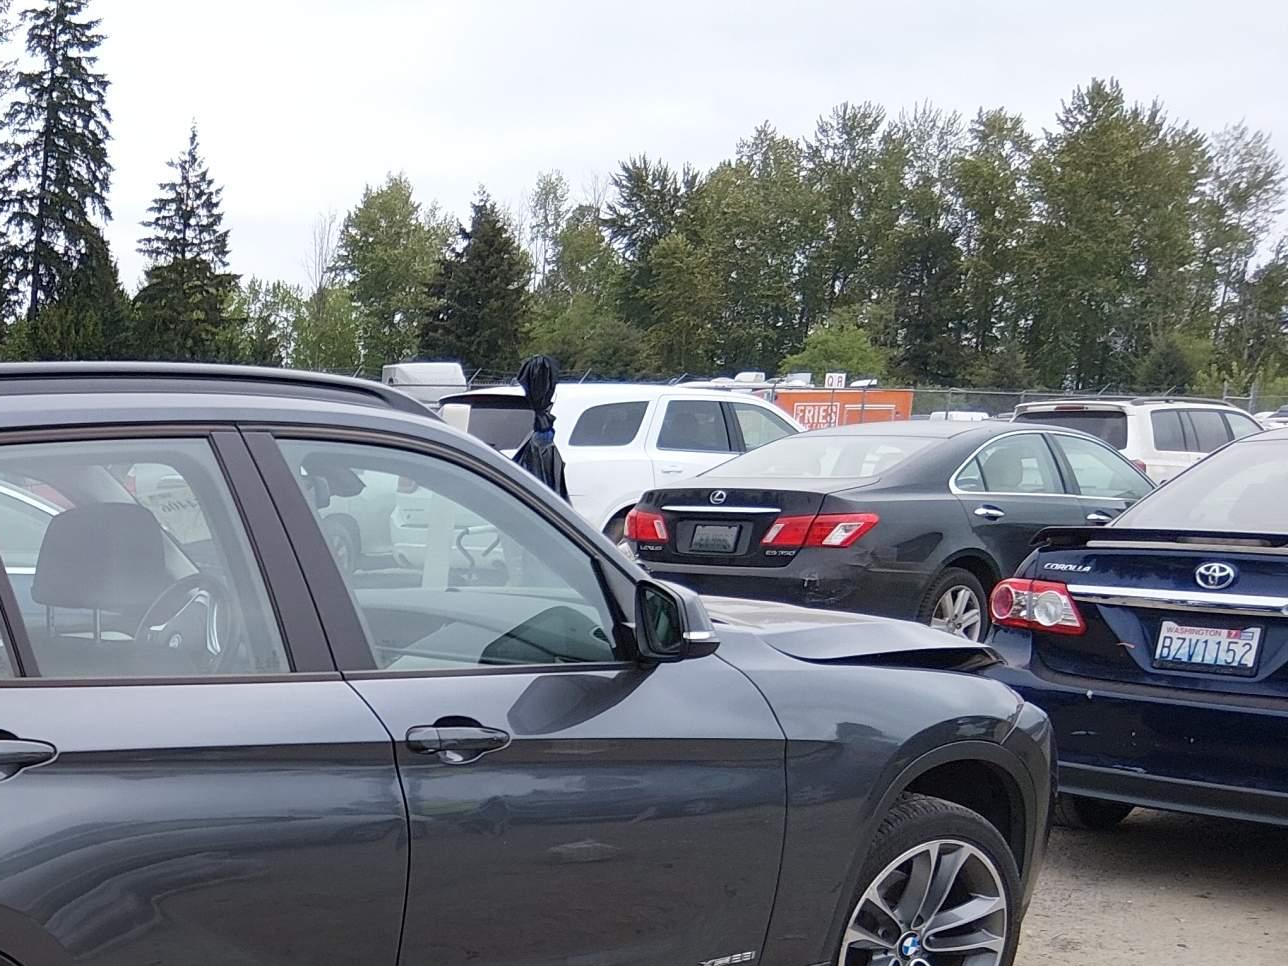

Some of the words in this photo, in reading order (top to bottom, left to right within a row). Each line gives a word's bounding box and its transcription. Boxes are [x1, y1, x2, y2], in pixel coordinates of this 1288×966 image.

[796, 405, 837, 424] FRIES
[1044, 562, 1092, 572] COROLLA
[1166, 626, 1222, 637] WASHINGTON
[1159, 635, 1253, 667] BZV1152
